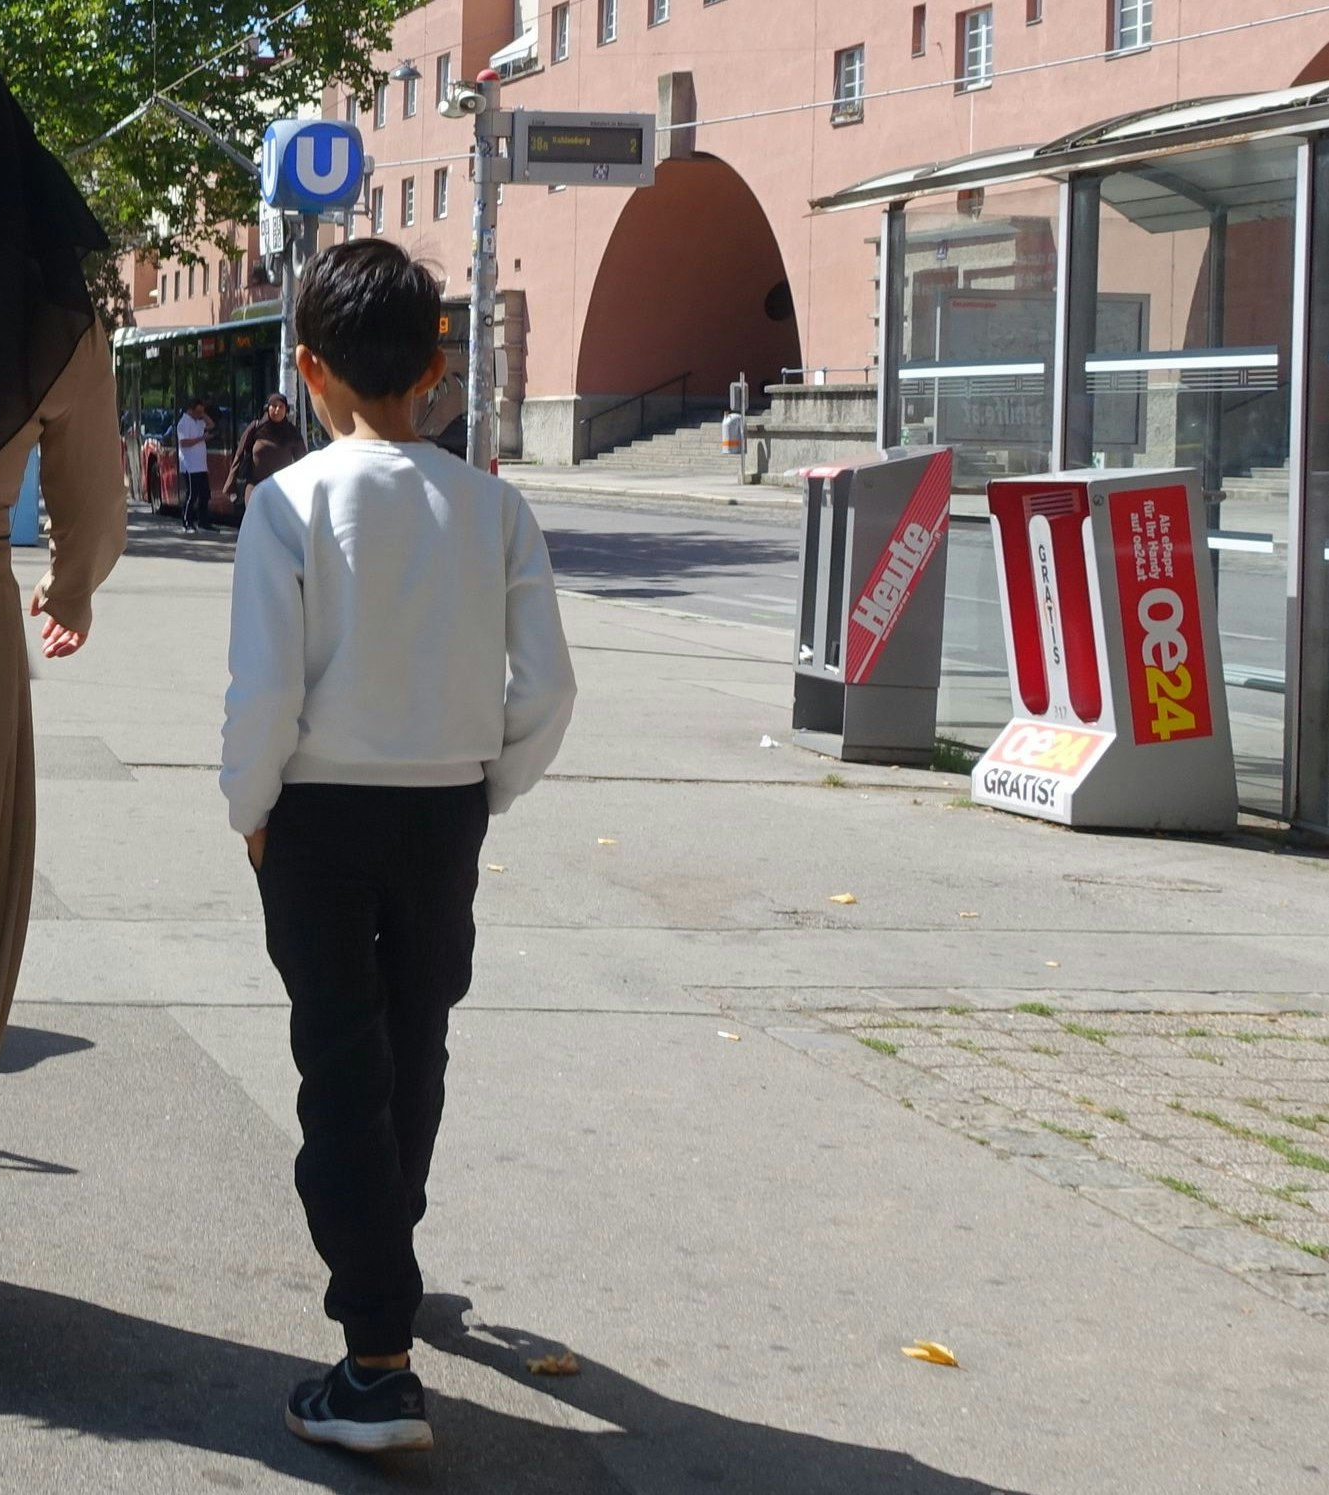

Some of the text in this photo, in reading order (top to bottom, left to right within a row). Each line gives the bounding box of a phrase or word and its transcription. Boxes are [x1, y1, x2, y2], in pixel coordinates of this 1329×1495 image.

[263, 138, 276, 197] U
[296, 136, 349, 195] U
[630, 138, 637, 153] 2
[1131, 513, 1147, 582] auf oe24.at
[1144, 500, 1161, 579] für Ihr Handy
[1159, 514, 1173, 578] Als ePaper
[852, 522, 931, 636] Heute
[1038, 544, 1061, 665] GRATIS
[1138, 588, 1196, 740] oe24
[1002, 726, 1091, 770] oe24
[984, 768, 1060, 807] GRATIS!
